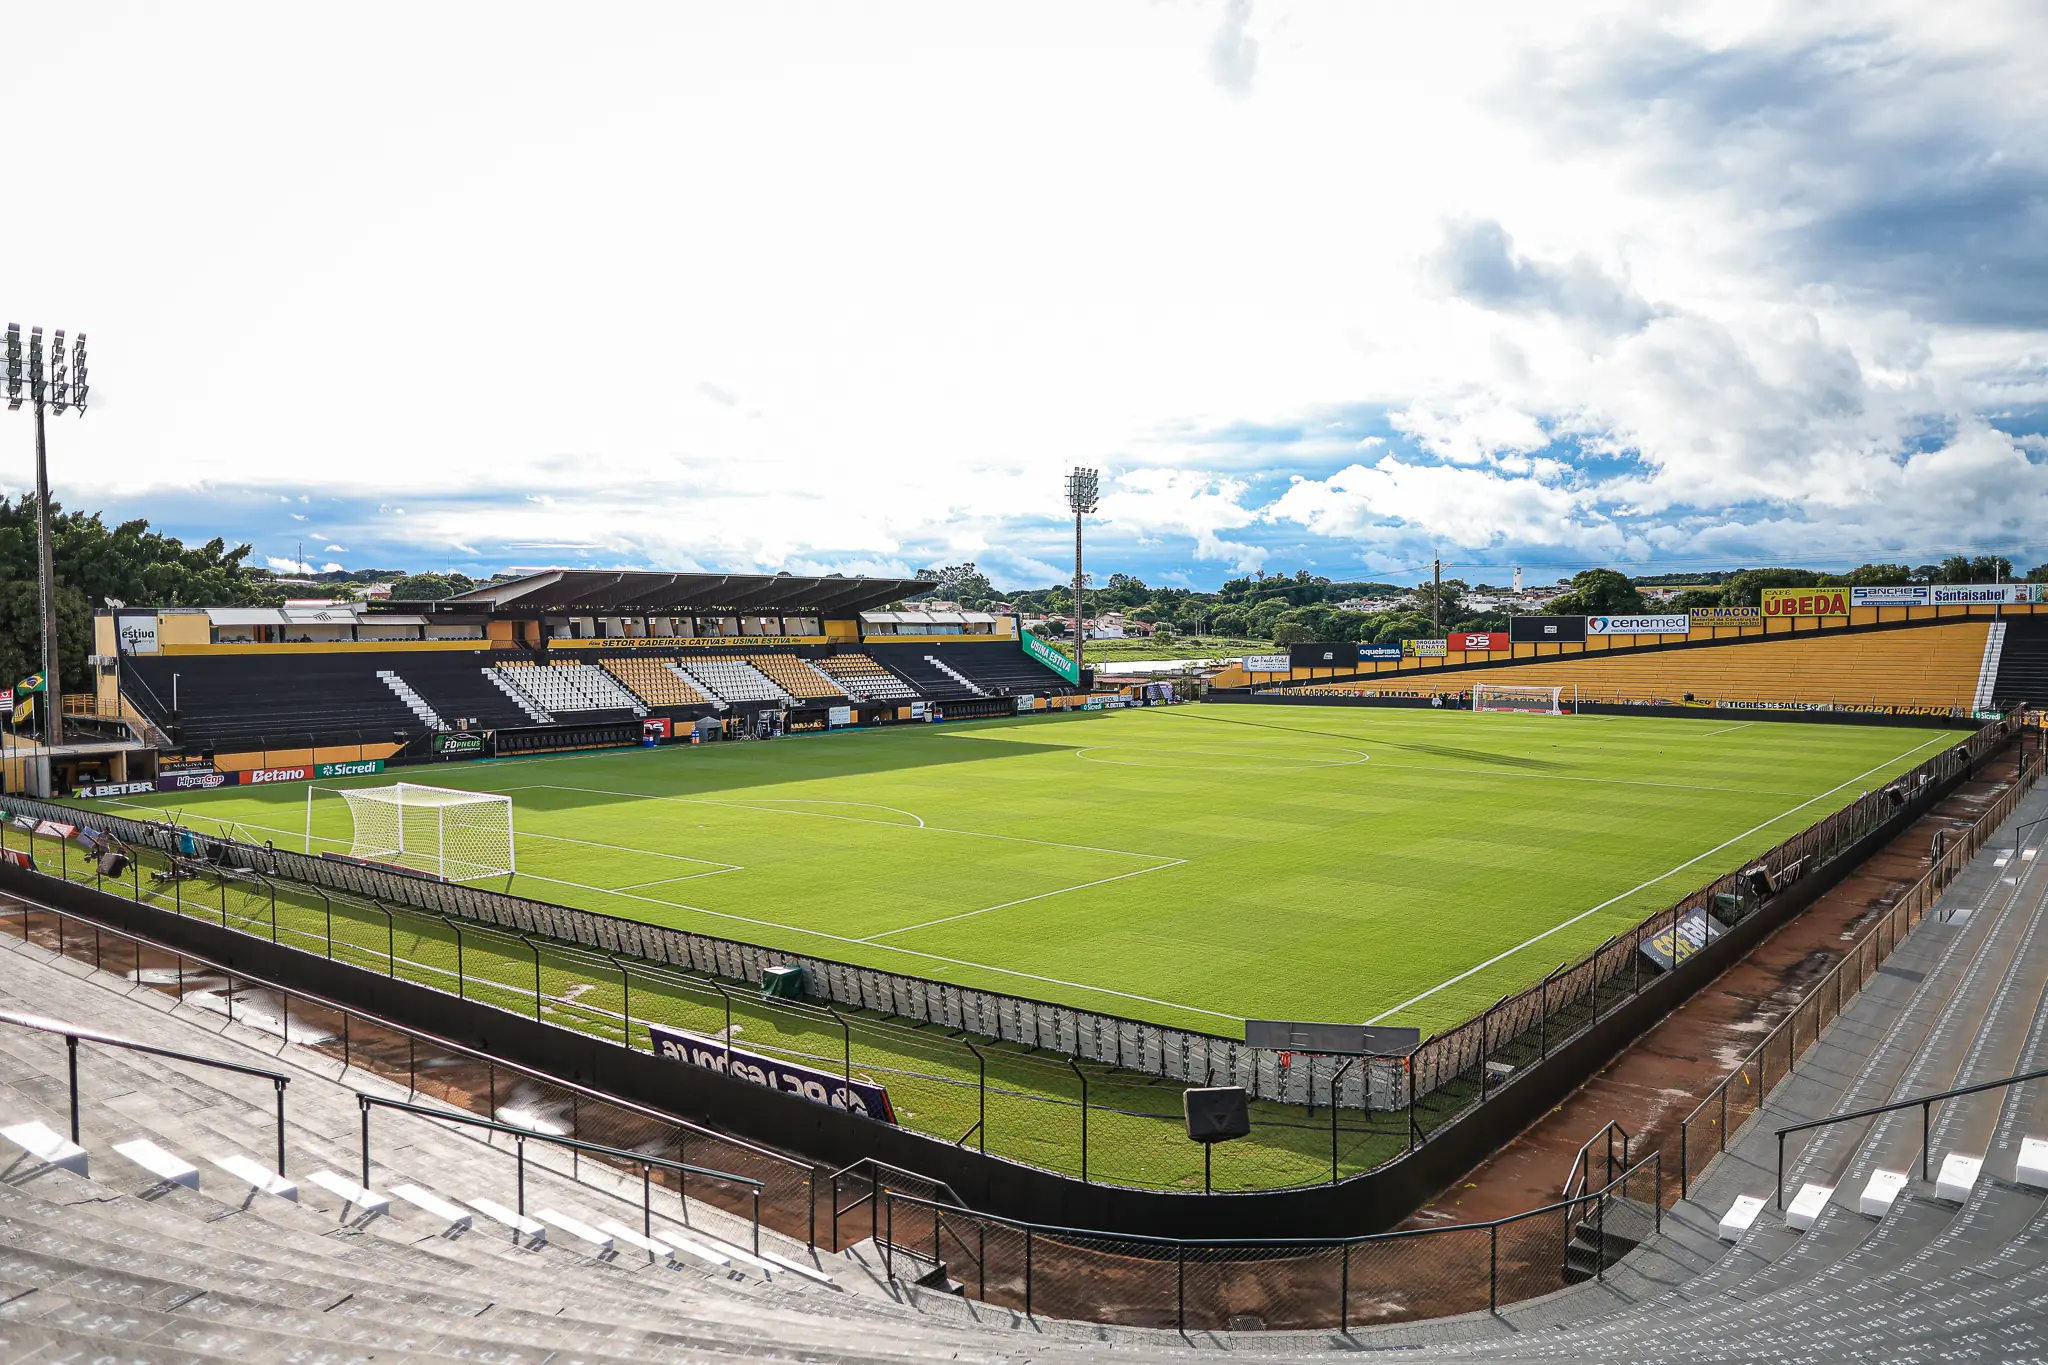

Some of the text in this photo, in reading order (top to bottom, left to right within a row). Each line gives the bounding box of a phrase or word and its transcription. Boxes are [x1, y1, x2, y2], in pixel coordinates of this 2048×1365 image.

[1935, 589, 2004, 601] Santaisabel
[1765, 594, 1846, 614] ÚBEDA
[1692, 608, 1758, 616] NO-MACON
[1611, 616, 1686, 628] cenemed
[122, 629, 154, 640] estiva
[1466, 636, 1490, 646] DS
[1030, 640, 1072, 672] USINA ESTIVA
[1980, 712, 2000, 720] Sicredi
[335, 762, 375, 775] Sicredi
[177, 774, 224, 787] HiperCap
[252, 769, 304, 783] Betano
[2004, 1277, 2025, 1288] 217
[1894, 1292, 1916, 1303] 217
[1788, 1305, 1809, 1315] 217
[1992, 1306, 2019, 1317] 221
[1860, 1319, 1887, 1329] 221
[2000, 1323, 2034, 1335] 224
